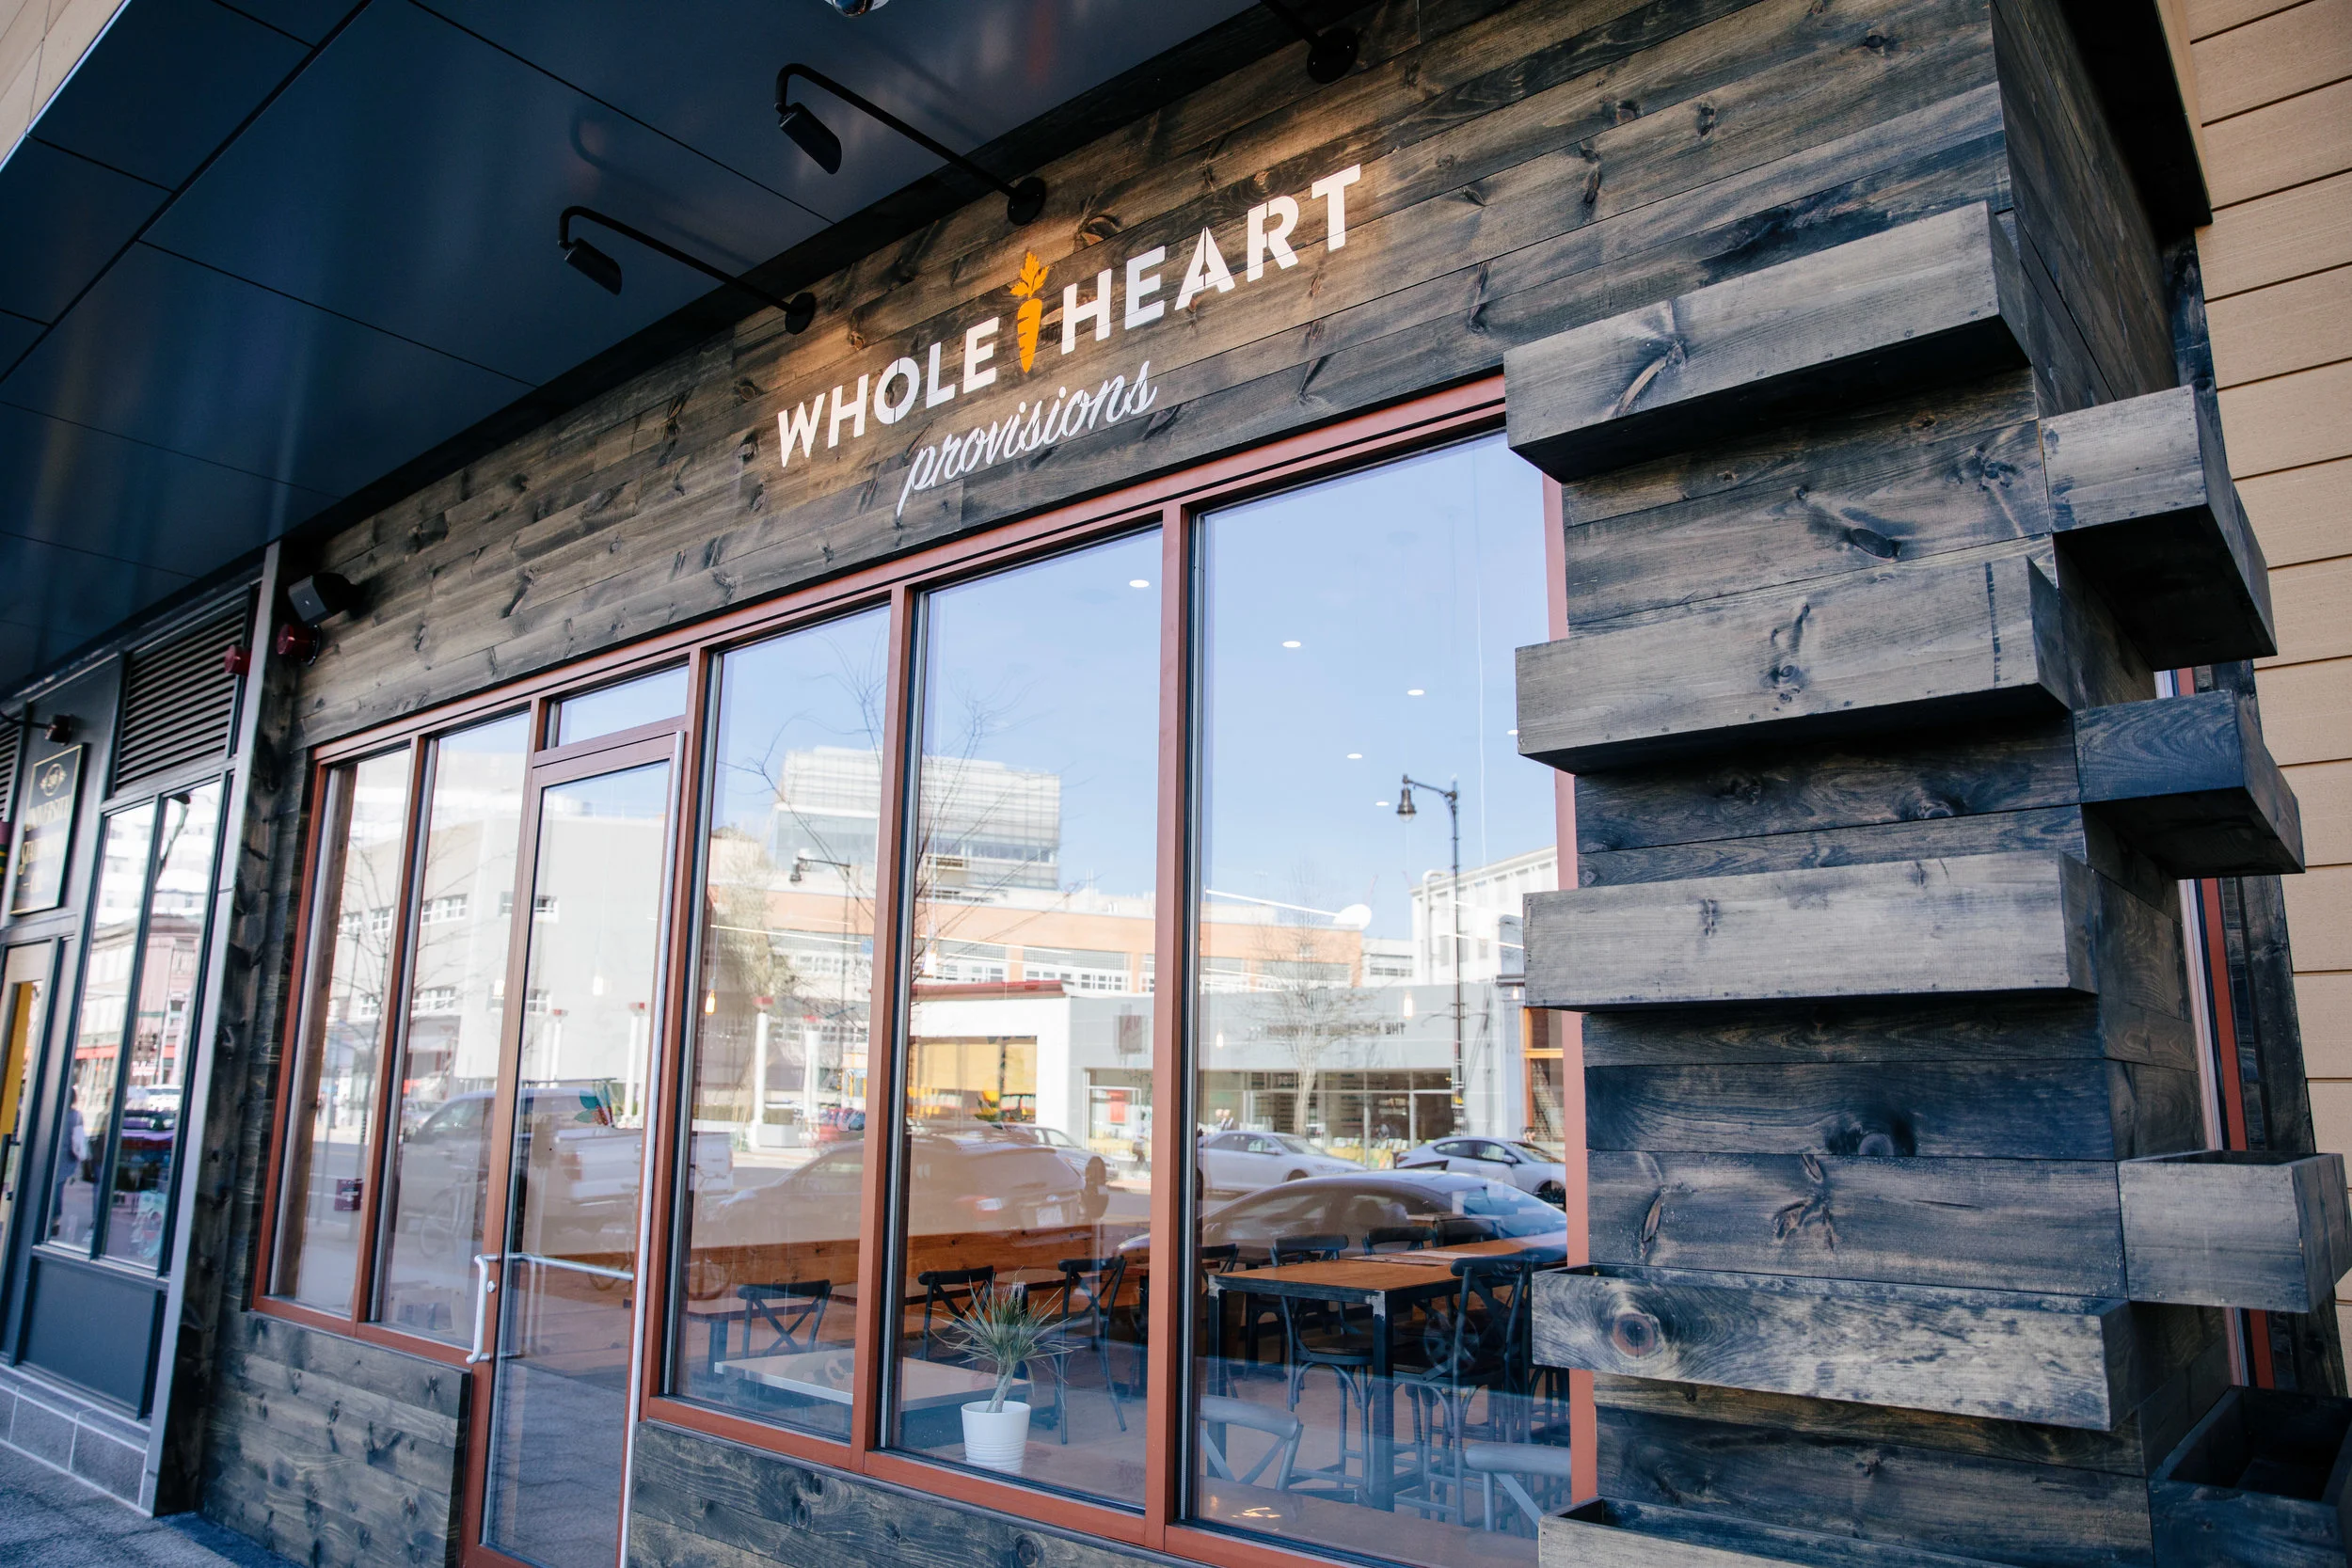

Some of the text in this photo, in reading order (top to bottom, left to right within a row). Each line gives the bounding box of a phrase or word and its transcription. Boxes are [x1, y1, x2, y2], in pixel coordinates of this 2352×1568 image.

[777, 163, 1362, 468] WHOLE HEART
[896, 360, 1158, 518] provisions
